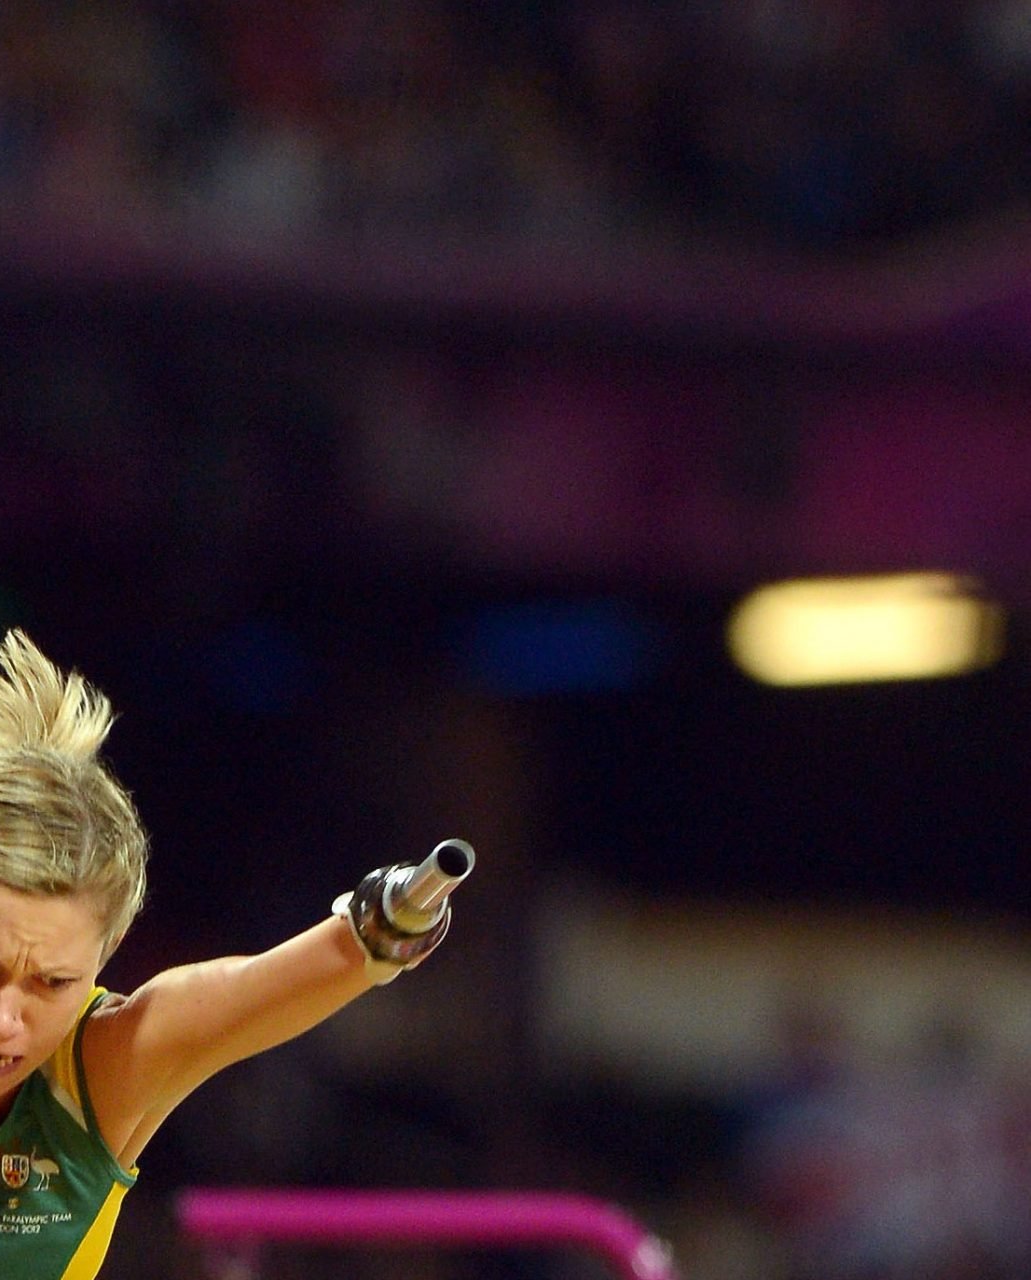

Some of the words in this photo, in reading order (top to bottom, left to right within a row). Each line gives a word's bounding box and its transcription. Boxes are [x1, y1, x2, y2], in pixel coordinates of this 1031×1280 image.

[2, 1213, 49, 1224] PARALYMPIC
[51, 1212, 72, 1222] TEAM
[21, 1224, 41, 1235] 2012
